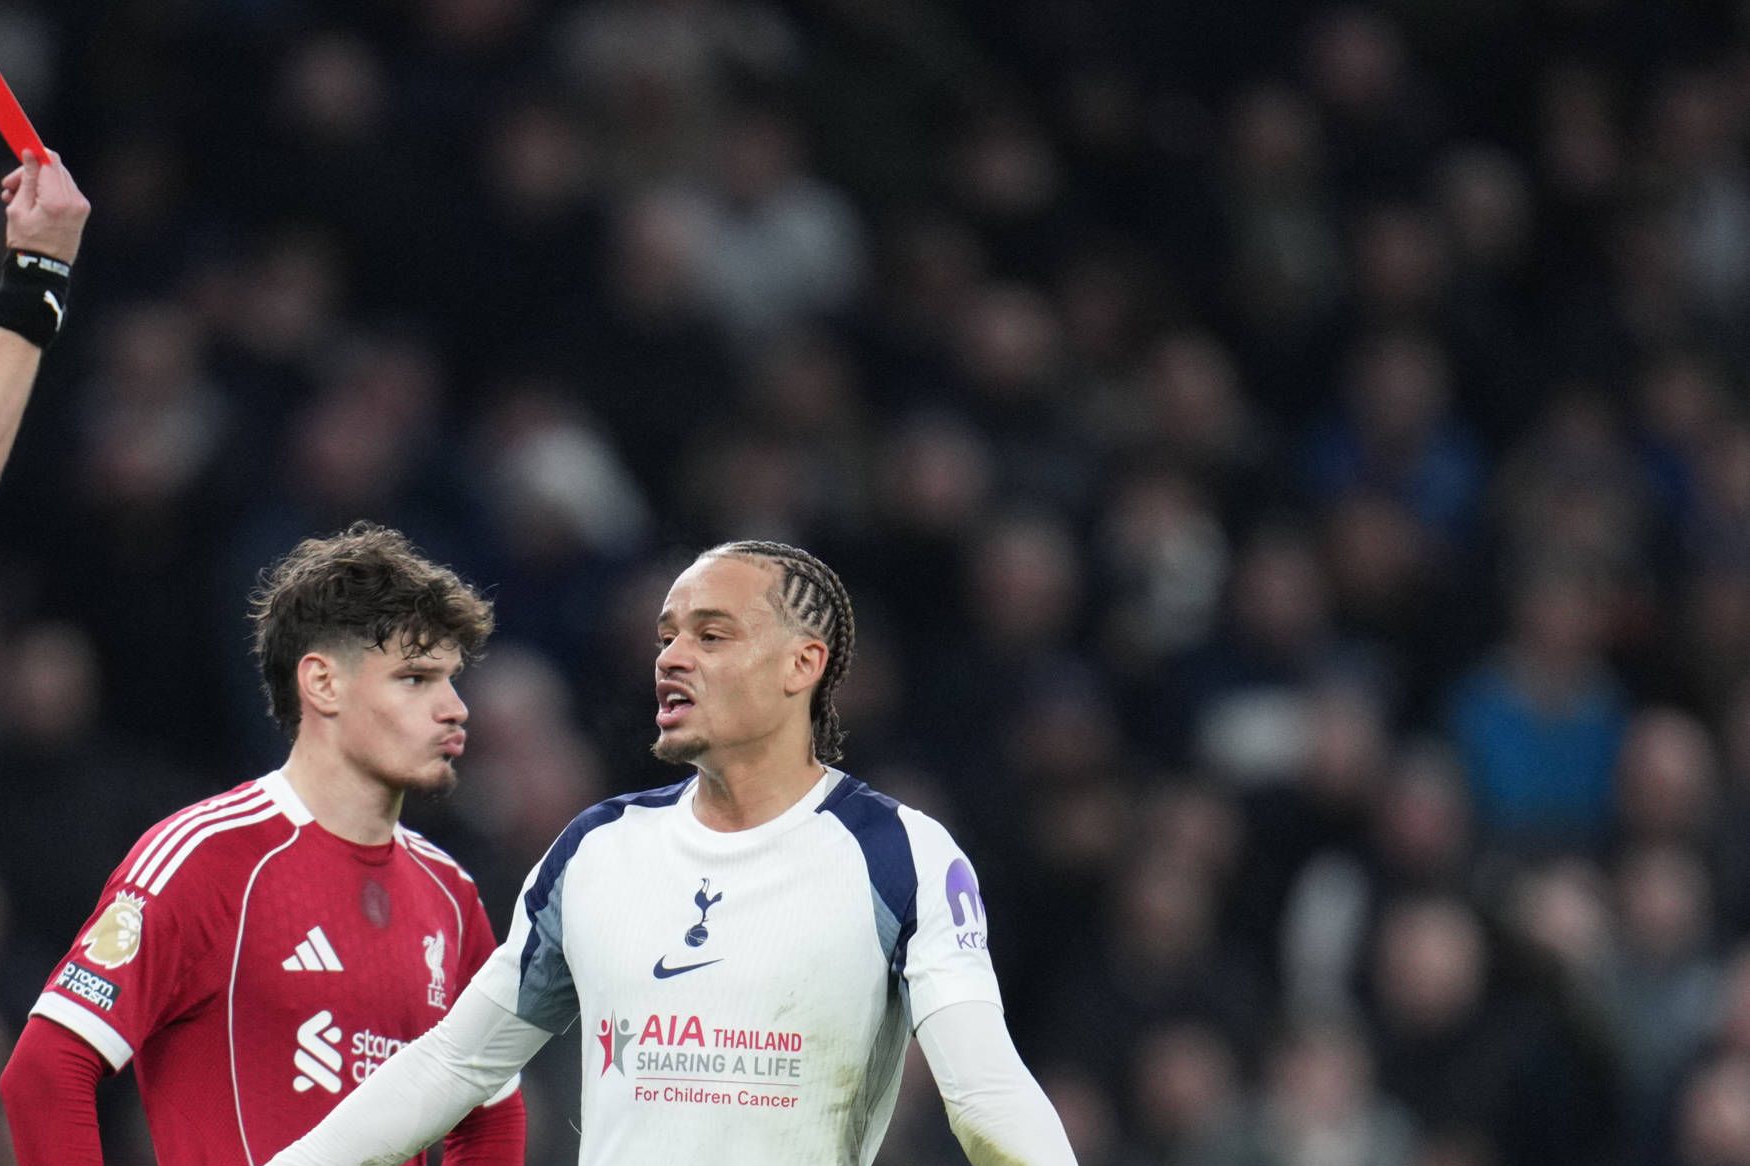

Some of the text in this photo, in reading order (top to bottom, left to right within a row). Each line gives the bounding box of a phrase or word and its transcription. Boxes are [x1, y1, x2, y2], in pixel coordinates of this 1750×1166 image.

[66, 979, 114, 1012] racism
[74, 968, 114, 997] room
[638, 1014, 802, 1052] AIA THAILAND
[636, 1051, 801, 1078] SHARING A LIFE
[635, 1086, 799, 1109] For Children Cancer
